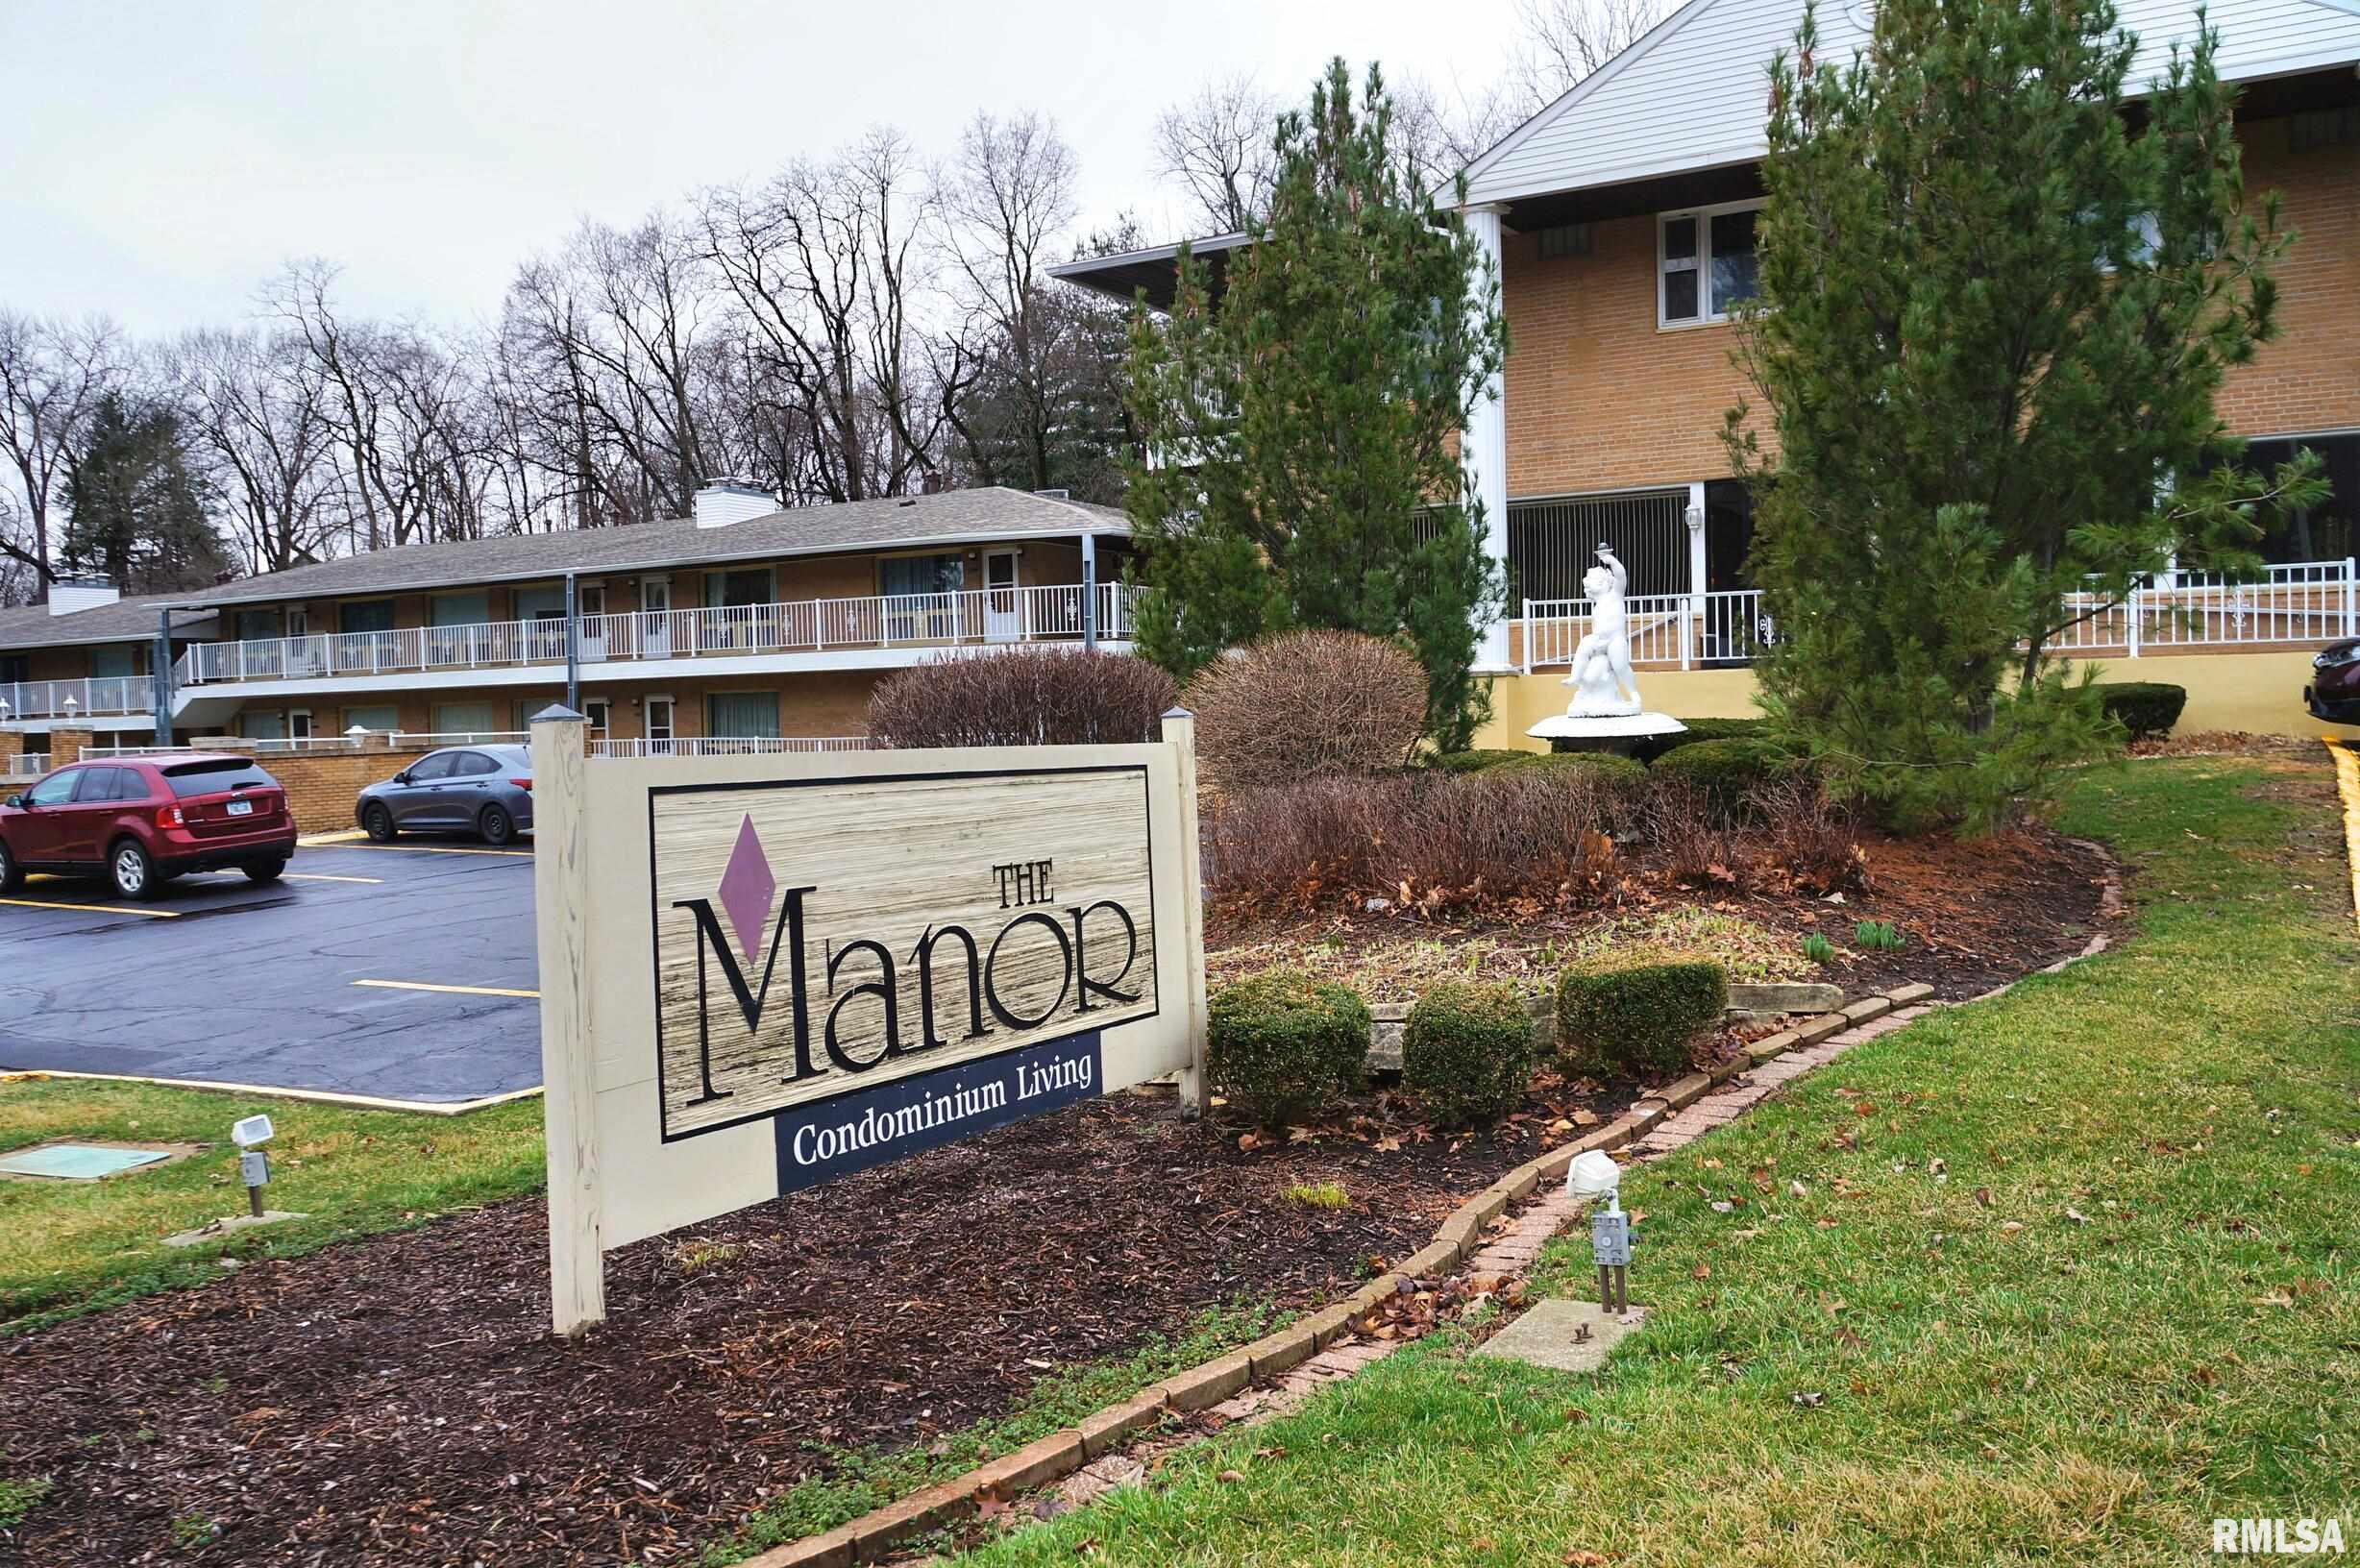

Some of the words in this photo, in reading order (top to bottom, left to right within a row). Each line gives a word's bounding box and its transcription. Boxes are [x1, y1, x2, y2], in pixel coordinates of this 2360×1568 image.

[992, 857, 1054, 909] THE
[793, 1079, 1008, 1166] Condominium
[1016, 1053, 1093, 1101] Living
